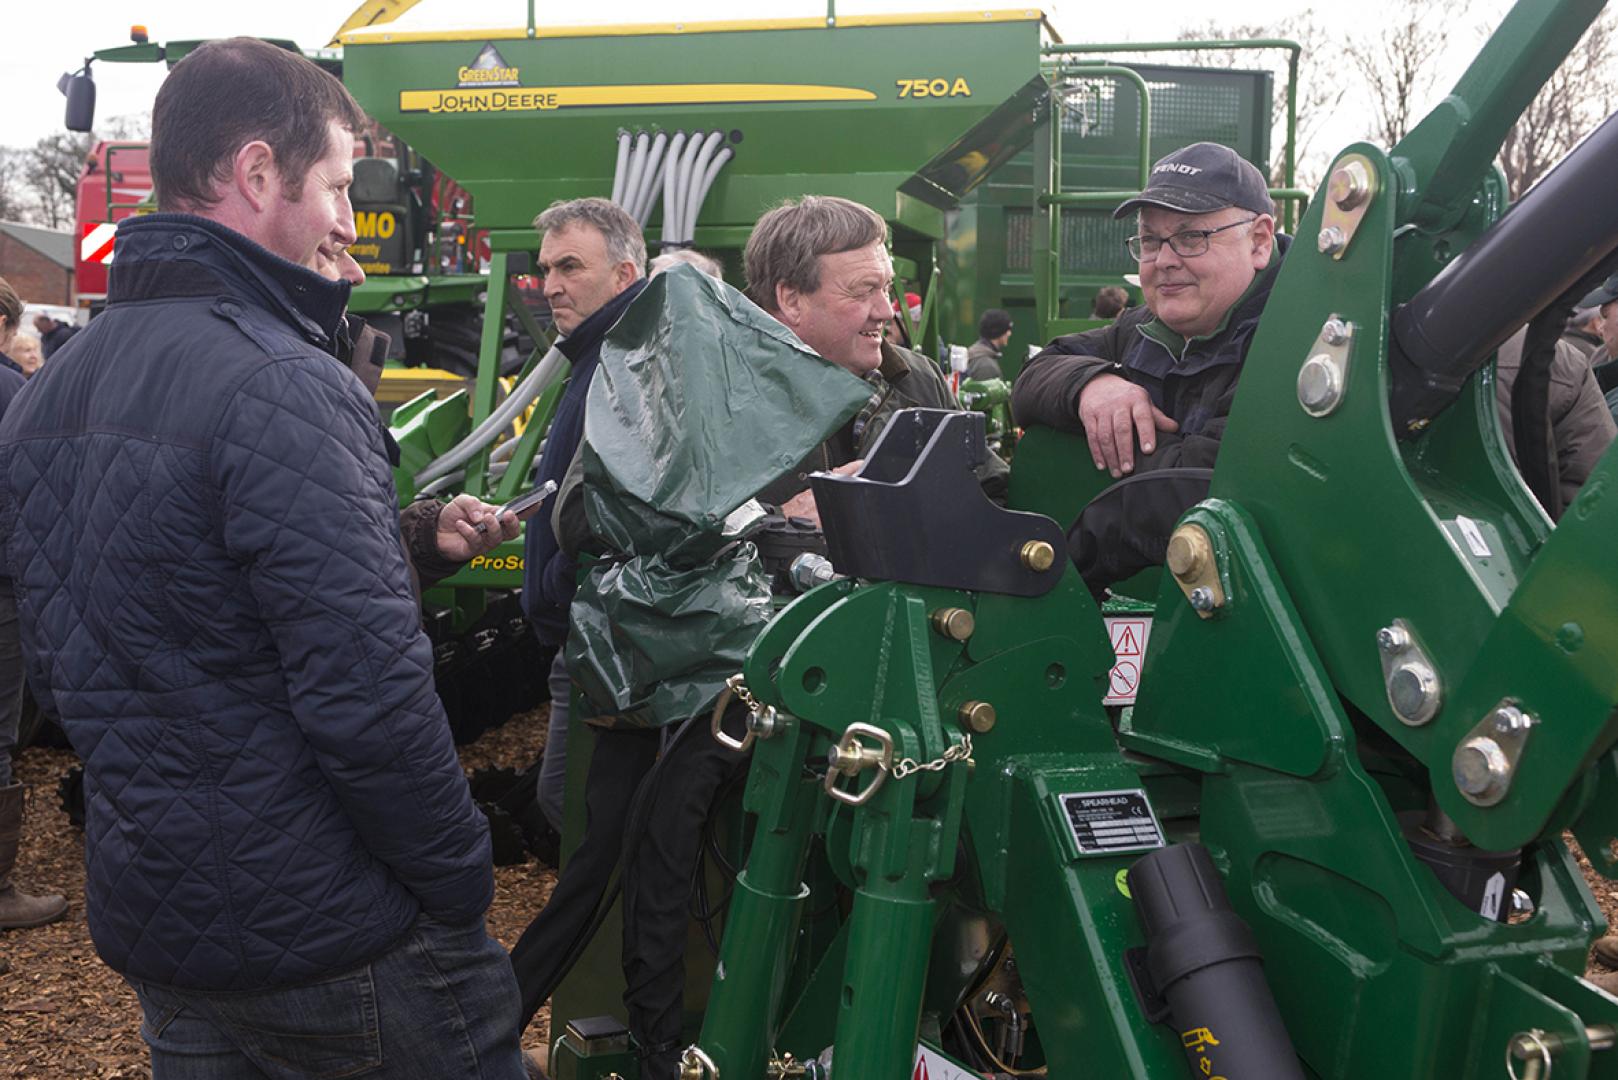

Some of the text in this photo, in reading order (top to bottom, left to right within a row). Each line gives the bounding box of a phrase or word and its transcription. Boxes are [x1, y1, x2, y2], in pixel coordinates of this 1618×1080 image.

[896, 77, 972, 97] 750A
[432, 92, 557, 109] JOHN DEERE
[353, 211, 395, 239] MO
